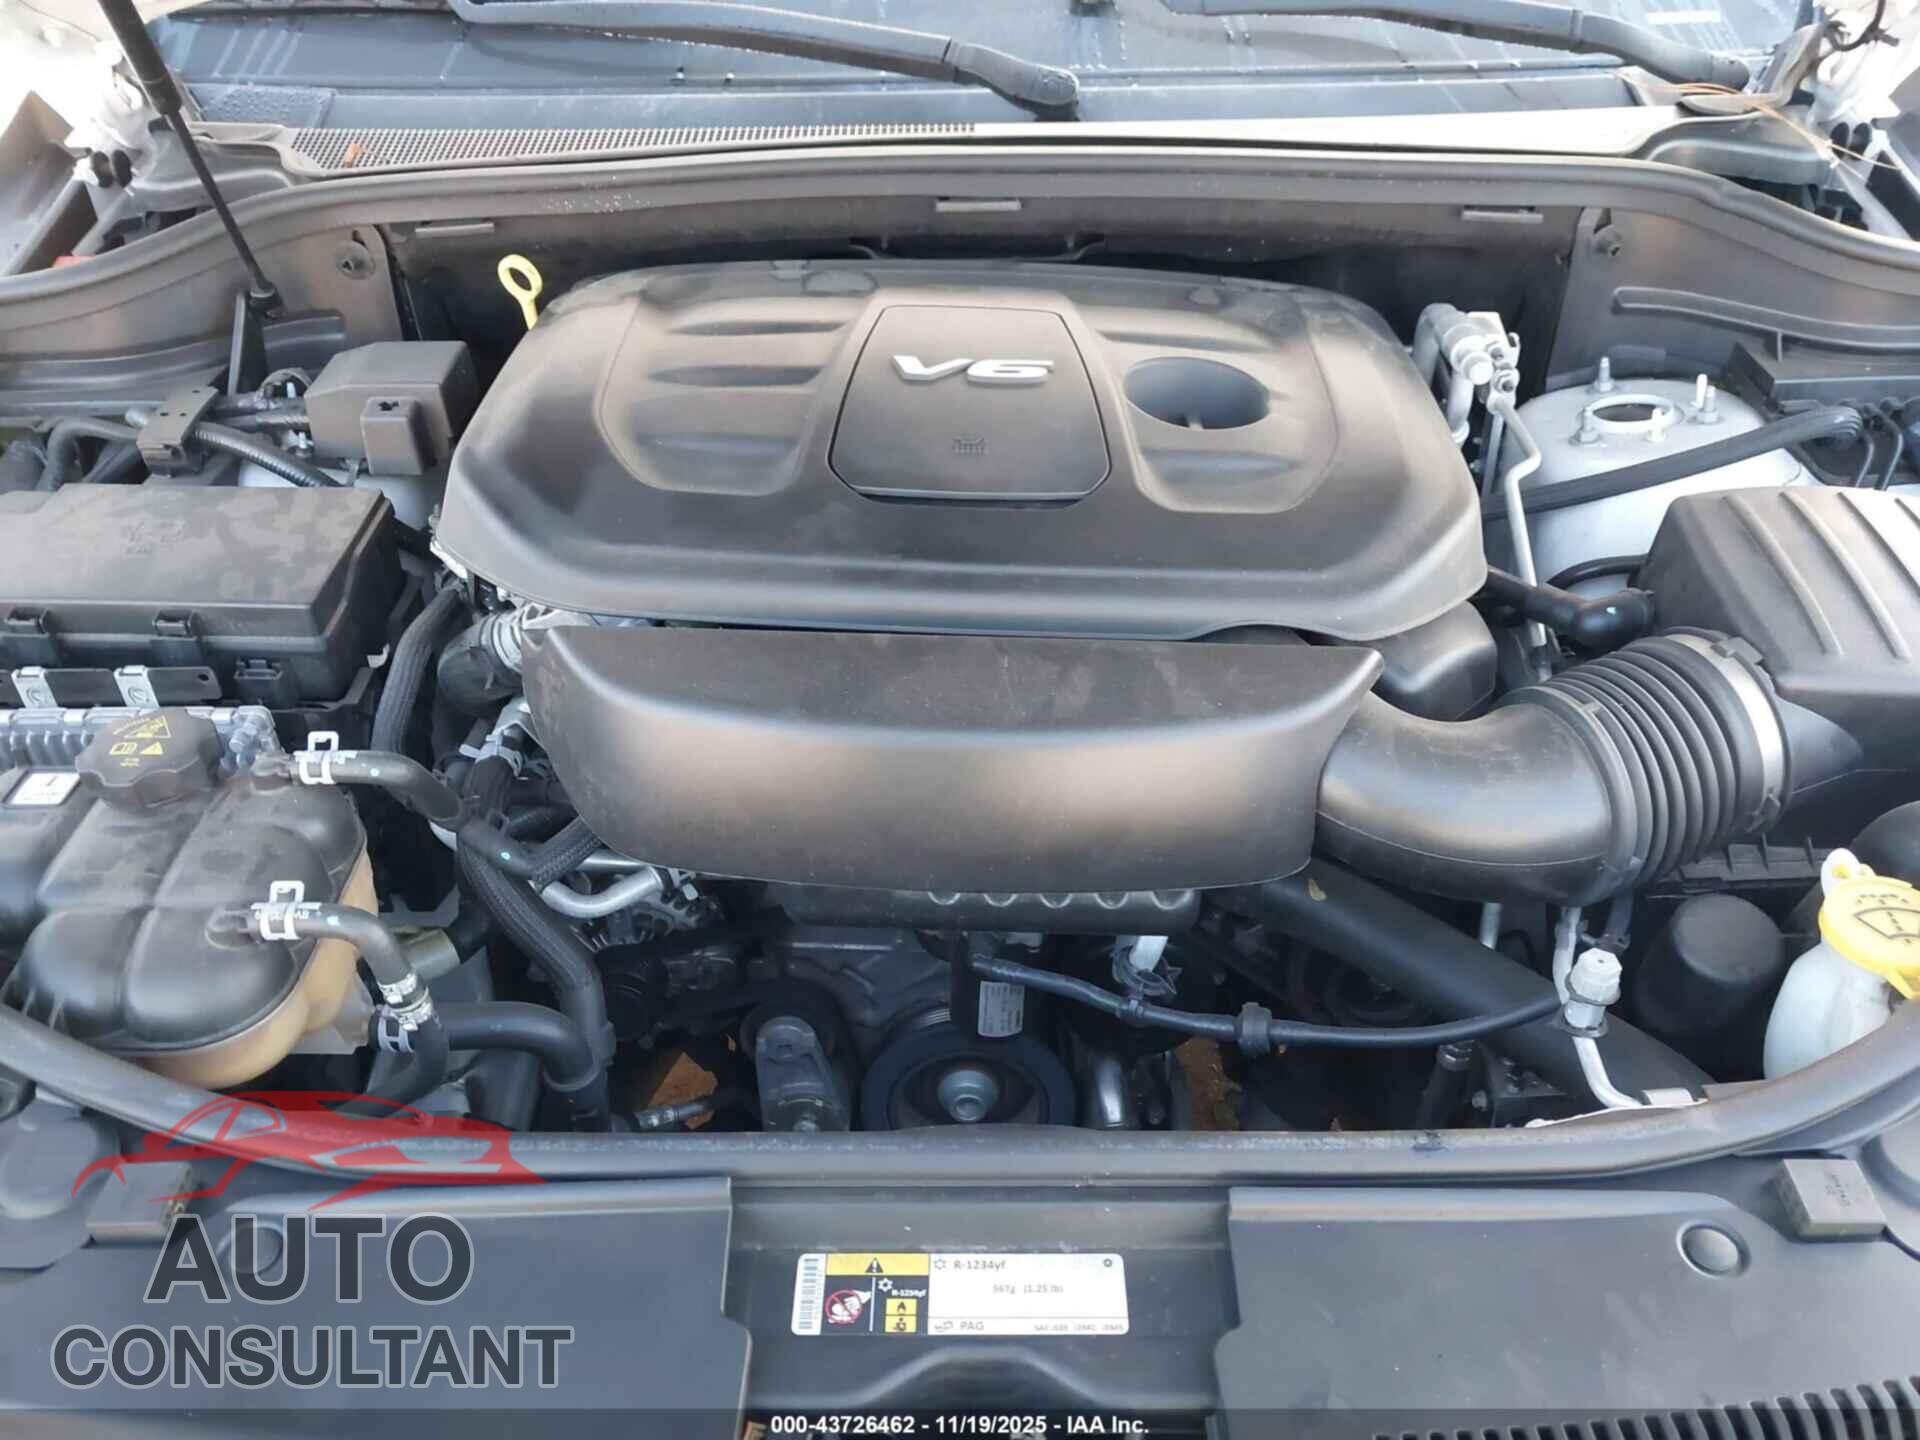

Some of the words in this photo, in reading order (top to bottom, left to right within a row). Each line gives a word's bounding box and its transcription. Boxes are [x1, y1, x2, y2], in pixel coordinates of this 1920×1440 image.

[891, 354, 1054, 385] V6
[953, 1260, 1006, 1272] R-1234yf
[959, 1320, 985, 1331] PAG
